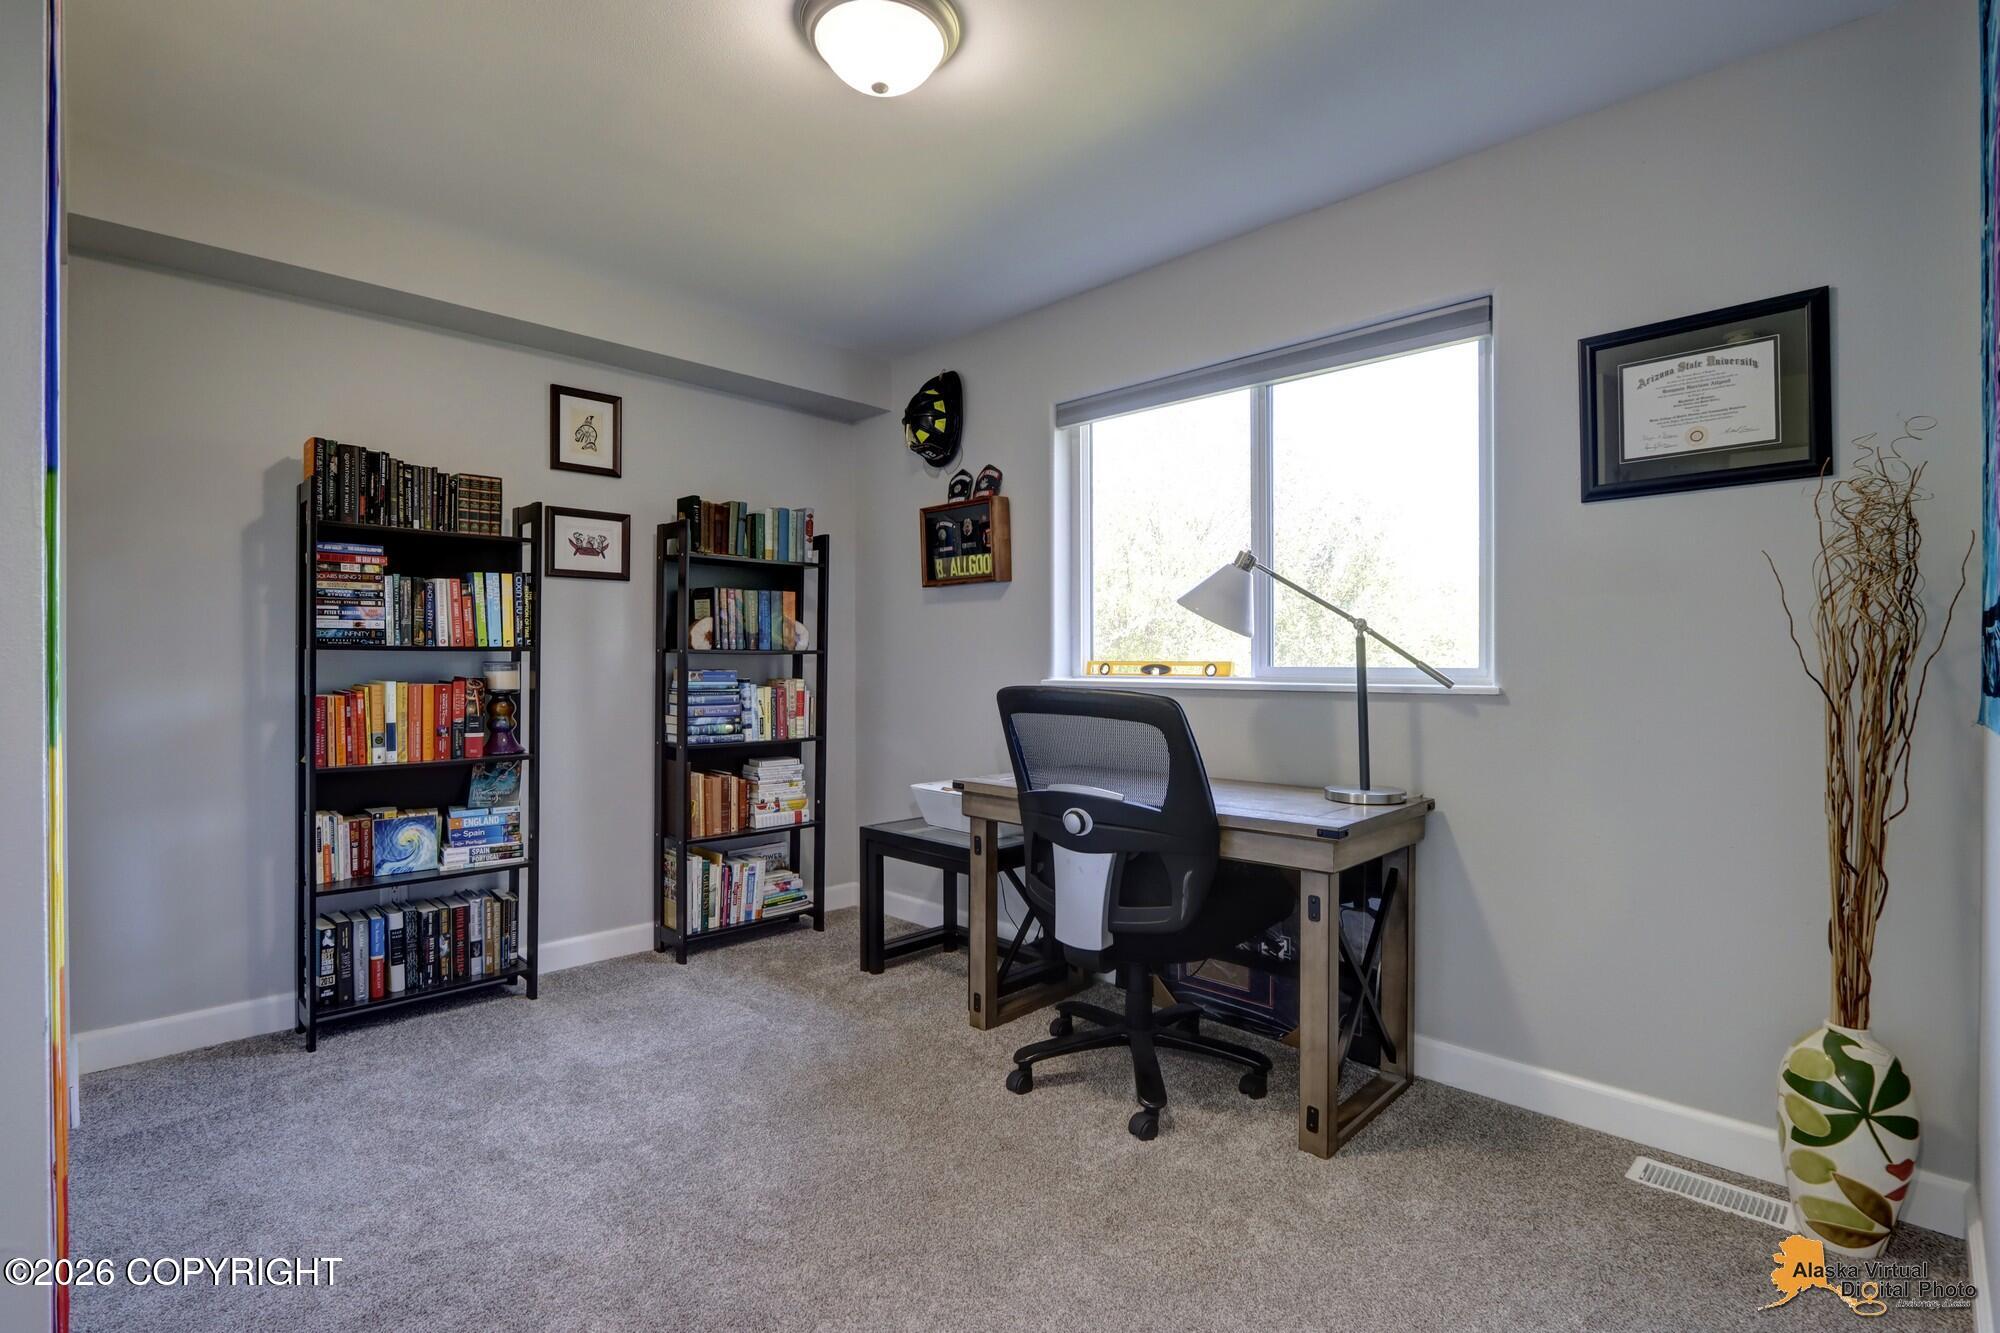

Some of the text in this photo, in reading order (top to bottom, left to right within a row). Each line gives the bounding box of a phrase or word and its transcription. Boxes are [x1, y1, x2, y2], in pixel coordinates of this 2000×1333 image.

[1637, 368, 1674, 390] Arizona
[1677, 361, 1703, 373] State
[1706, 356, 1759, 368] University
[936, 553, 992, 578] B. ALLGOO
[463, 816, 499, 828] ENGLAND
[463, 829, 485, 838] Spain
[472, 854, 499, 862] PORTUGAL
